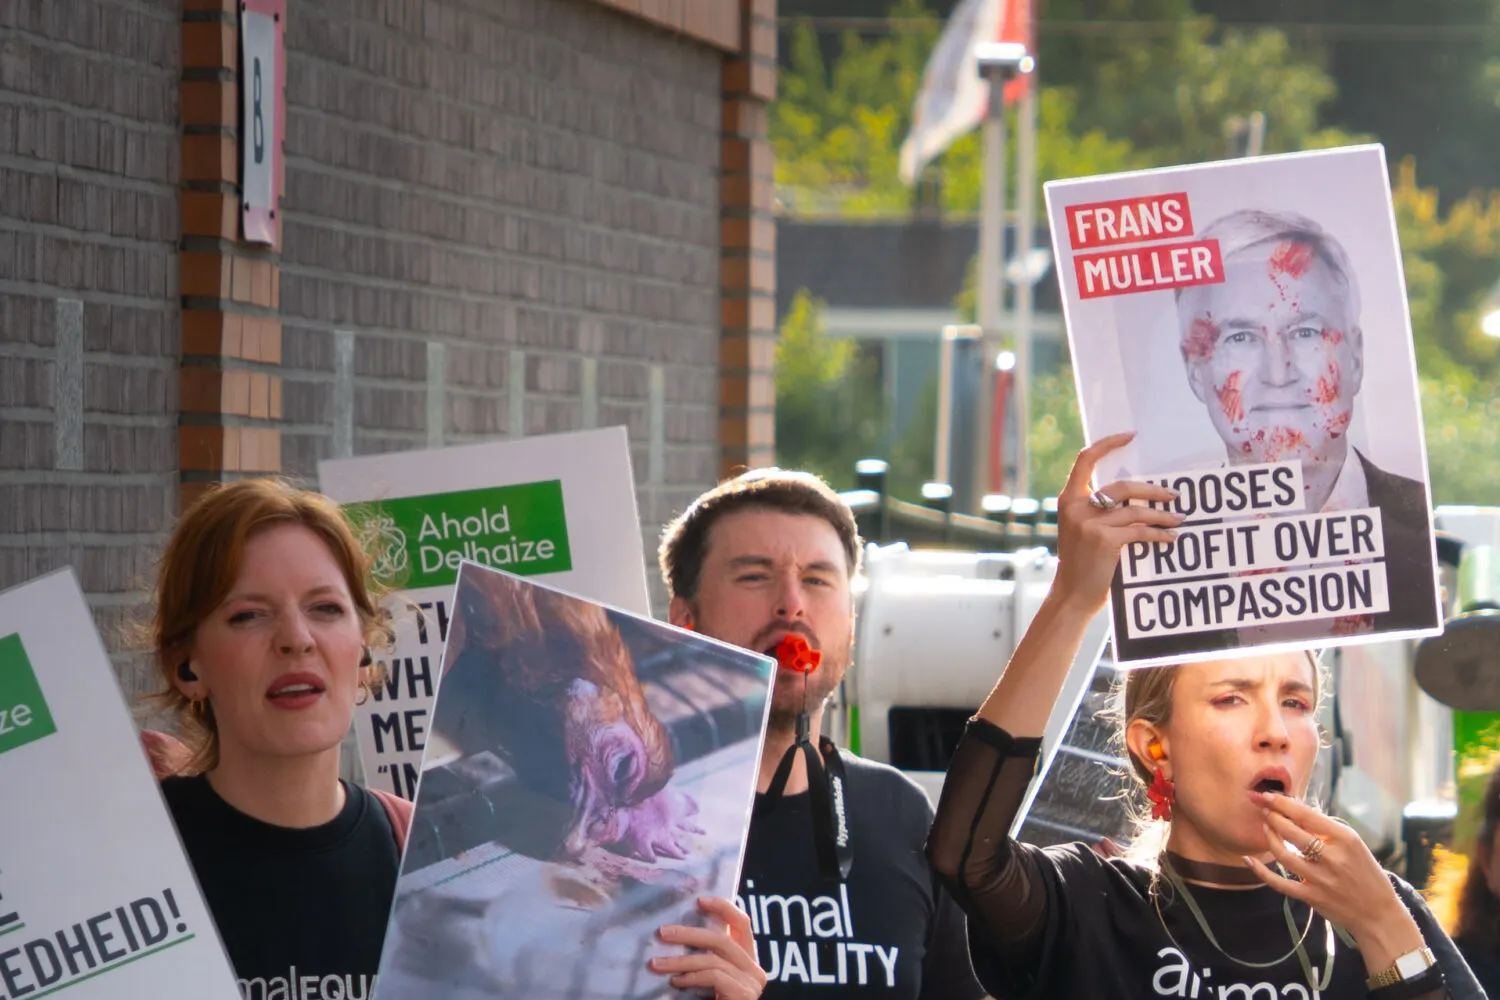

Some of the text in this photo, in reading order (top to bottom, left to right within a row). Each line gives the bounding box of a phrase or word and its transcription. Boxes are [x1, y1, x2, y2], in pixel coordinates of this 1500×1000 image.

[1075, 199, 1184, 242] FRANS
[1082, 247, 1215, 293] MULLER
[1122, 468, 1296, 516] OOSES
[418, 505, 511, 542] Ahold
[1128, 514, 1376, 577] PROFIT OVER
[420, 536, 555, 573] Delhaize
[1132, 570, 1374, 631] COMPASSION
